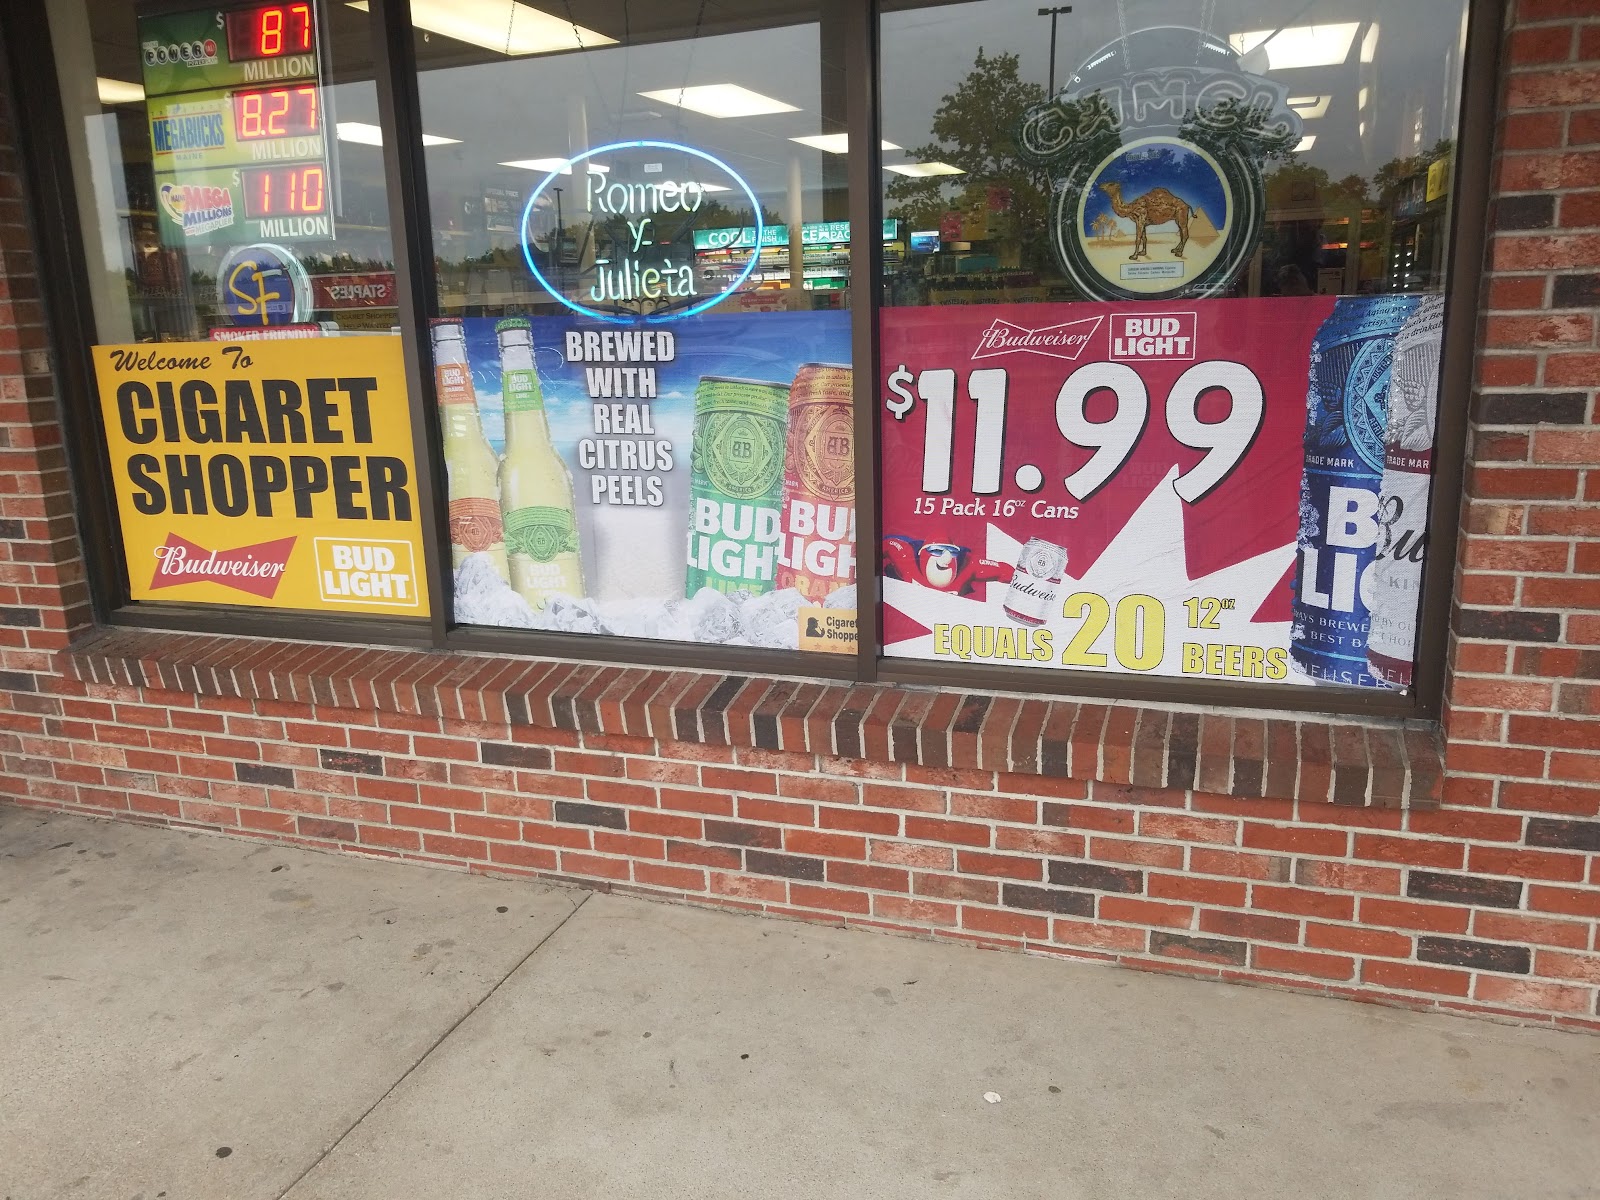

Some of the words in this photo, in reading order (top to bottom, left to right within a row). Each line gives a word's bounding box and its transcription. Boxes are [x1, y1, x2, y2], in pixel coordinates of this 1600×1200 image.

[261, 6, 309, 54] 87
[244, 56, 314, 81] MILLION
[243, 88, 316, 137] 8.27
[1022, 78, 1291, 154] CAMEL
[153, 113, 224, 151] MEGABUCKS
[252, 138, 321, 160] MILLION
[182, 186, 231, 212] MEGA
[263, 169, 323, 212] 110
[586, 170, 702, 214] Romeo
[183, 207, 232, 227] MILLIONS
[260, 216, 329, 238] MILLION
[708, 231, 751, 246] COOL
[228, 260, 282, 326] SF
[590, 258, 698, 302] Julieta
[213, 330, 260, 341] SMOKER
[983, 327, 1090, 350] Budweiser
[1125, 317, 1180, 337] BUD
[110, 349, 212, 372] Welcome
[222, 346, 253, 370] To
[565, 331, 676, 363] BREWED
[1114, 337, 1190, 356] LIGHT
[509, 383, 533, 391] LIGHT
[585, 367, 658, 398] WITH
[116, 377, 378, 444] CIGARET
[593, 403, 656, 435] REAL
[885, 360, 1267, 506] $11.99
[578, 439, 675, 472] CITRUS
[1327, 456, 1354, 469] MARK
[127, 453, 413, 521] SHOPPER
[591, 474, 665, 507] PEELS
[696, 497, 781, 544] BUD
[789, 499, 856, 541] BU
[913, 497, 936, 516] 15
[940, 498, 986, 517] Pack
[1031, 500, 1080, 520] Cans
[153, 546, 286, 579] Budweiser
[332, 545, 395, 571] BUD
[687, 531, 774, 581] LIGH
[323, 571, 410, 599] LIGHT
[934, 623, 1054, 662] EQUALS
[1061, 591, 1167, 671] 20
[1182, 642, 1288, 680] BEERS
[1310, 630, 1345, 645] BEST
